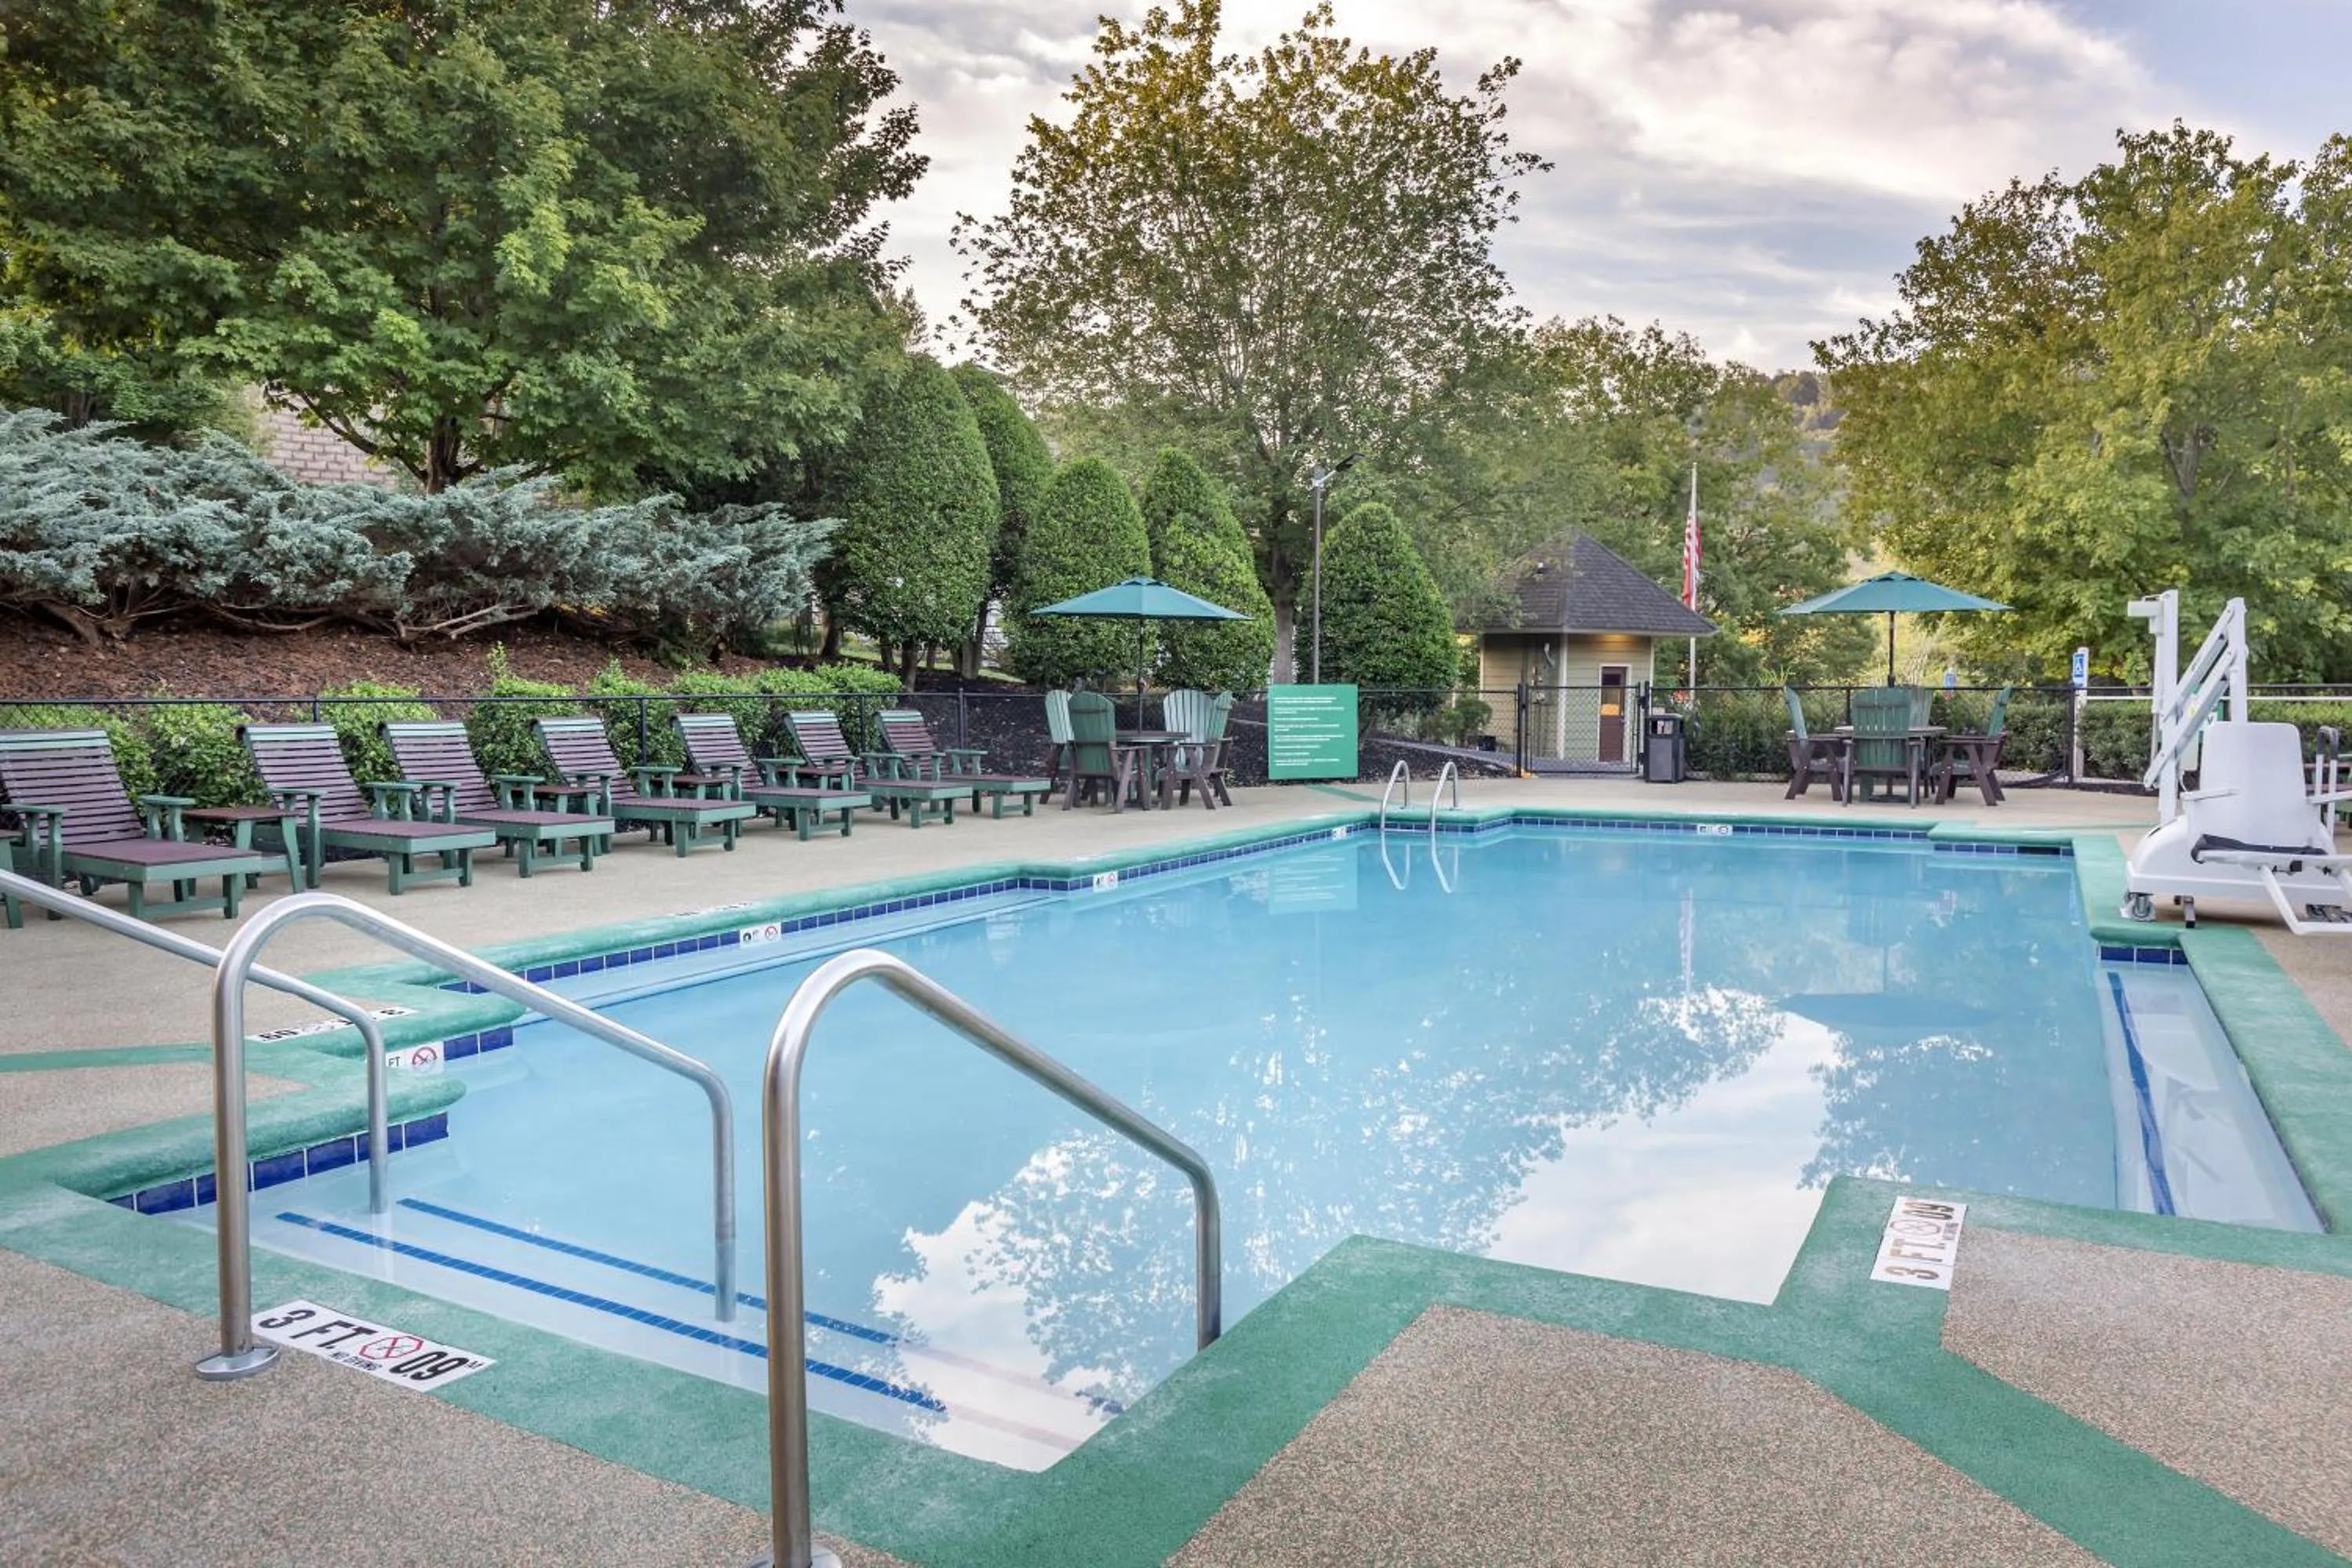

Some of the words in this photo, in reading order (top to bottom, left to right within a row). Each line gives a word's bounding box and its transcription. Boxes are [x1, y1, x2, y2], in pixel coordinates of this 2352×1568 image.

[389, 1056, 400, 1067] FT
[1884, 1266, 1940, 1280] 3
[259, 1308, 316, 1329] 3
[289, 1319, 378, 1349] FT.
